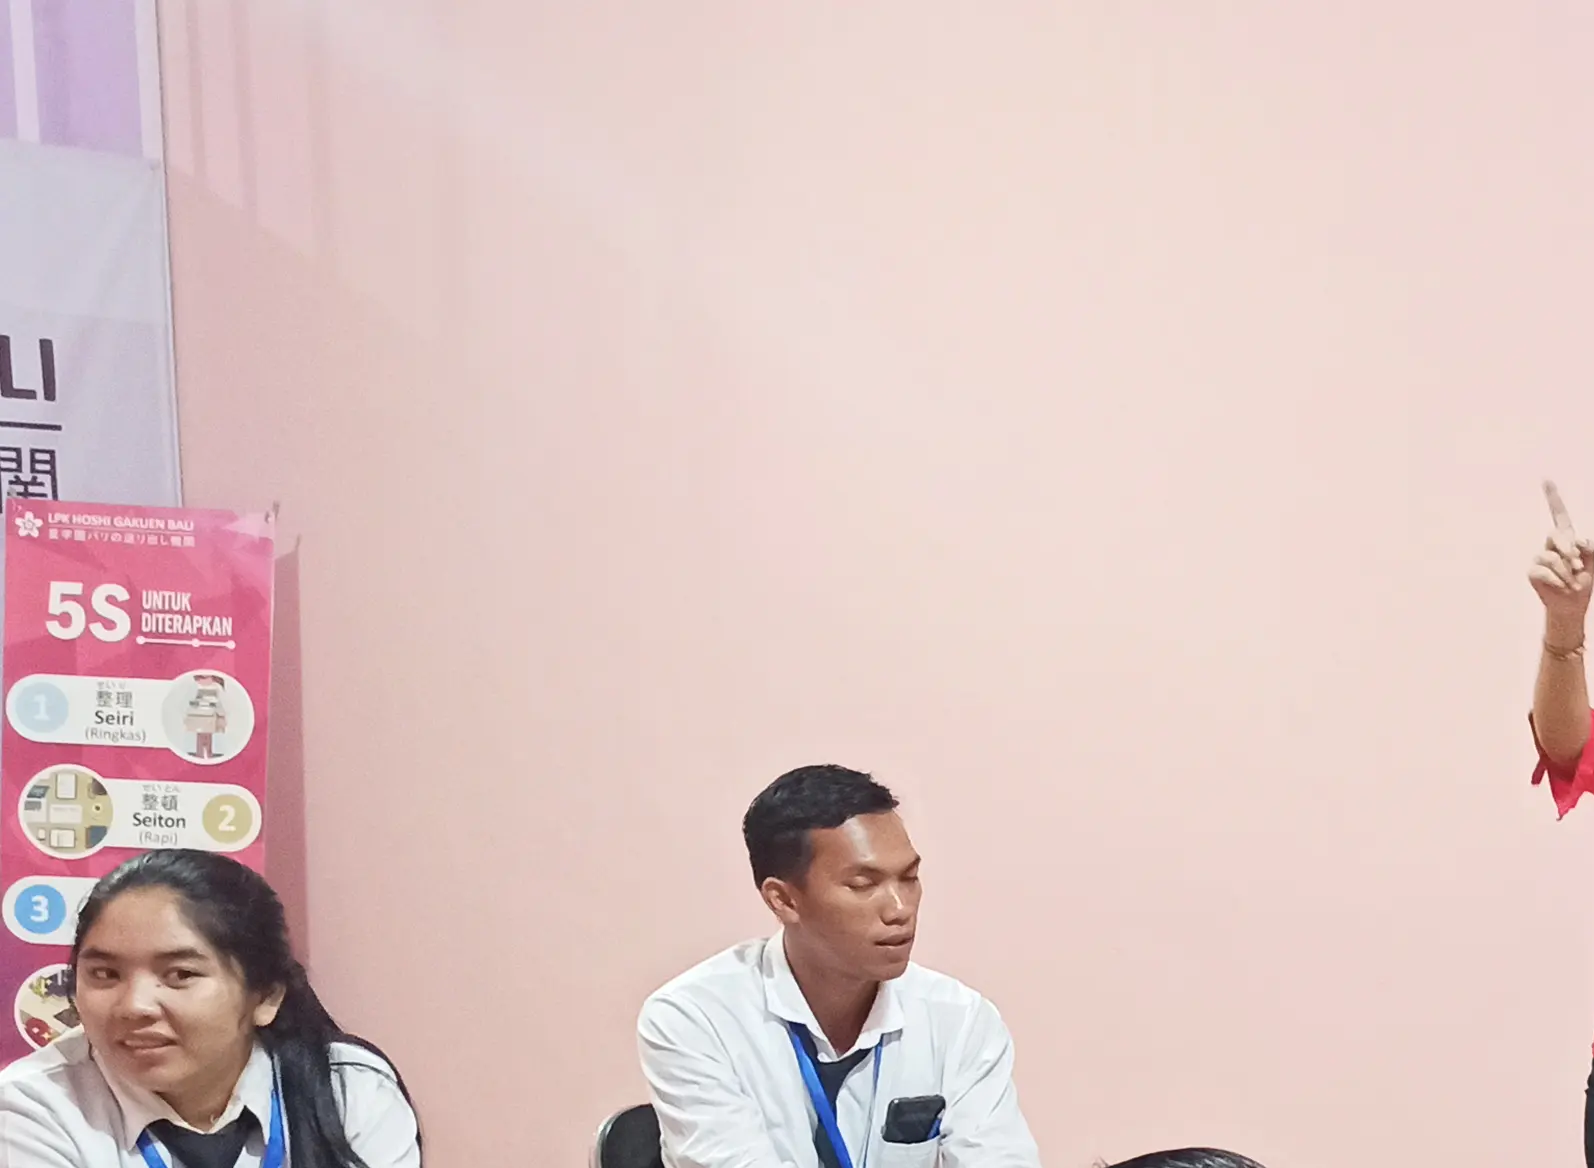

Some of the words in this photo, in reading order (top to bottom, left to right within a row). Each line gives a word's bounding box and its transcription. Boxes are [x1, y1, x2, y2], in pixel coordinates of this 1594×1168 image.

[48, 512, 70, 524] LPK
[72, 514, 111, 527] HOSHI
[113, 516, 165, 530] GAKUEN
[167, 519, 195, 532] BALI
[45, 580, 132, 642] 5S
[142, 590, 192, 612] UNTUK
[141, 613, 234, 637] DITERAPKAN
[32, 694, 50, 721] 1
[95, 690, 134, 708] 整理
[94, 709, 135, 727] Seiri
[85, 726, 147, 744] (Ringkas)
[132, 812, 187, 830] Seiton
[217, 804, 237, 832] 2
[138, 829, 179, 846] (Rapi)
[29, 894, 50, 923] 3
